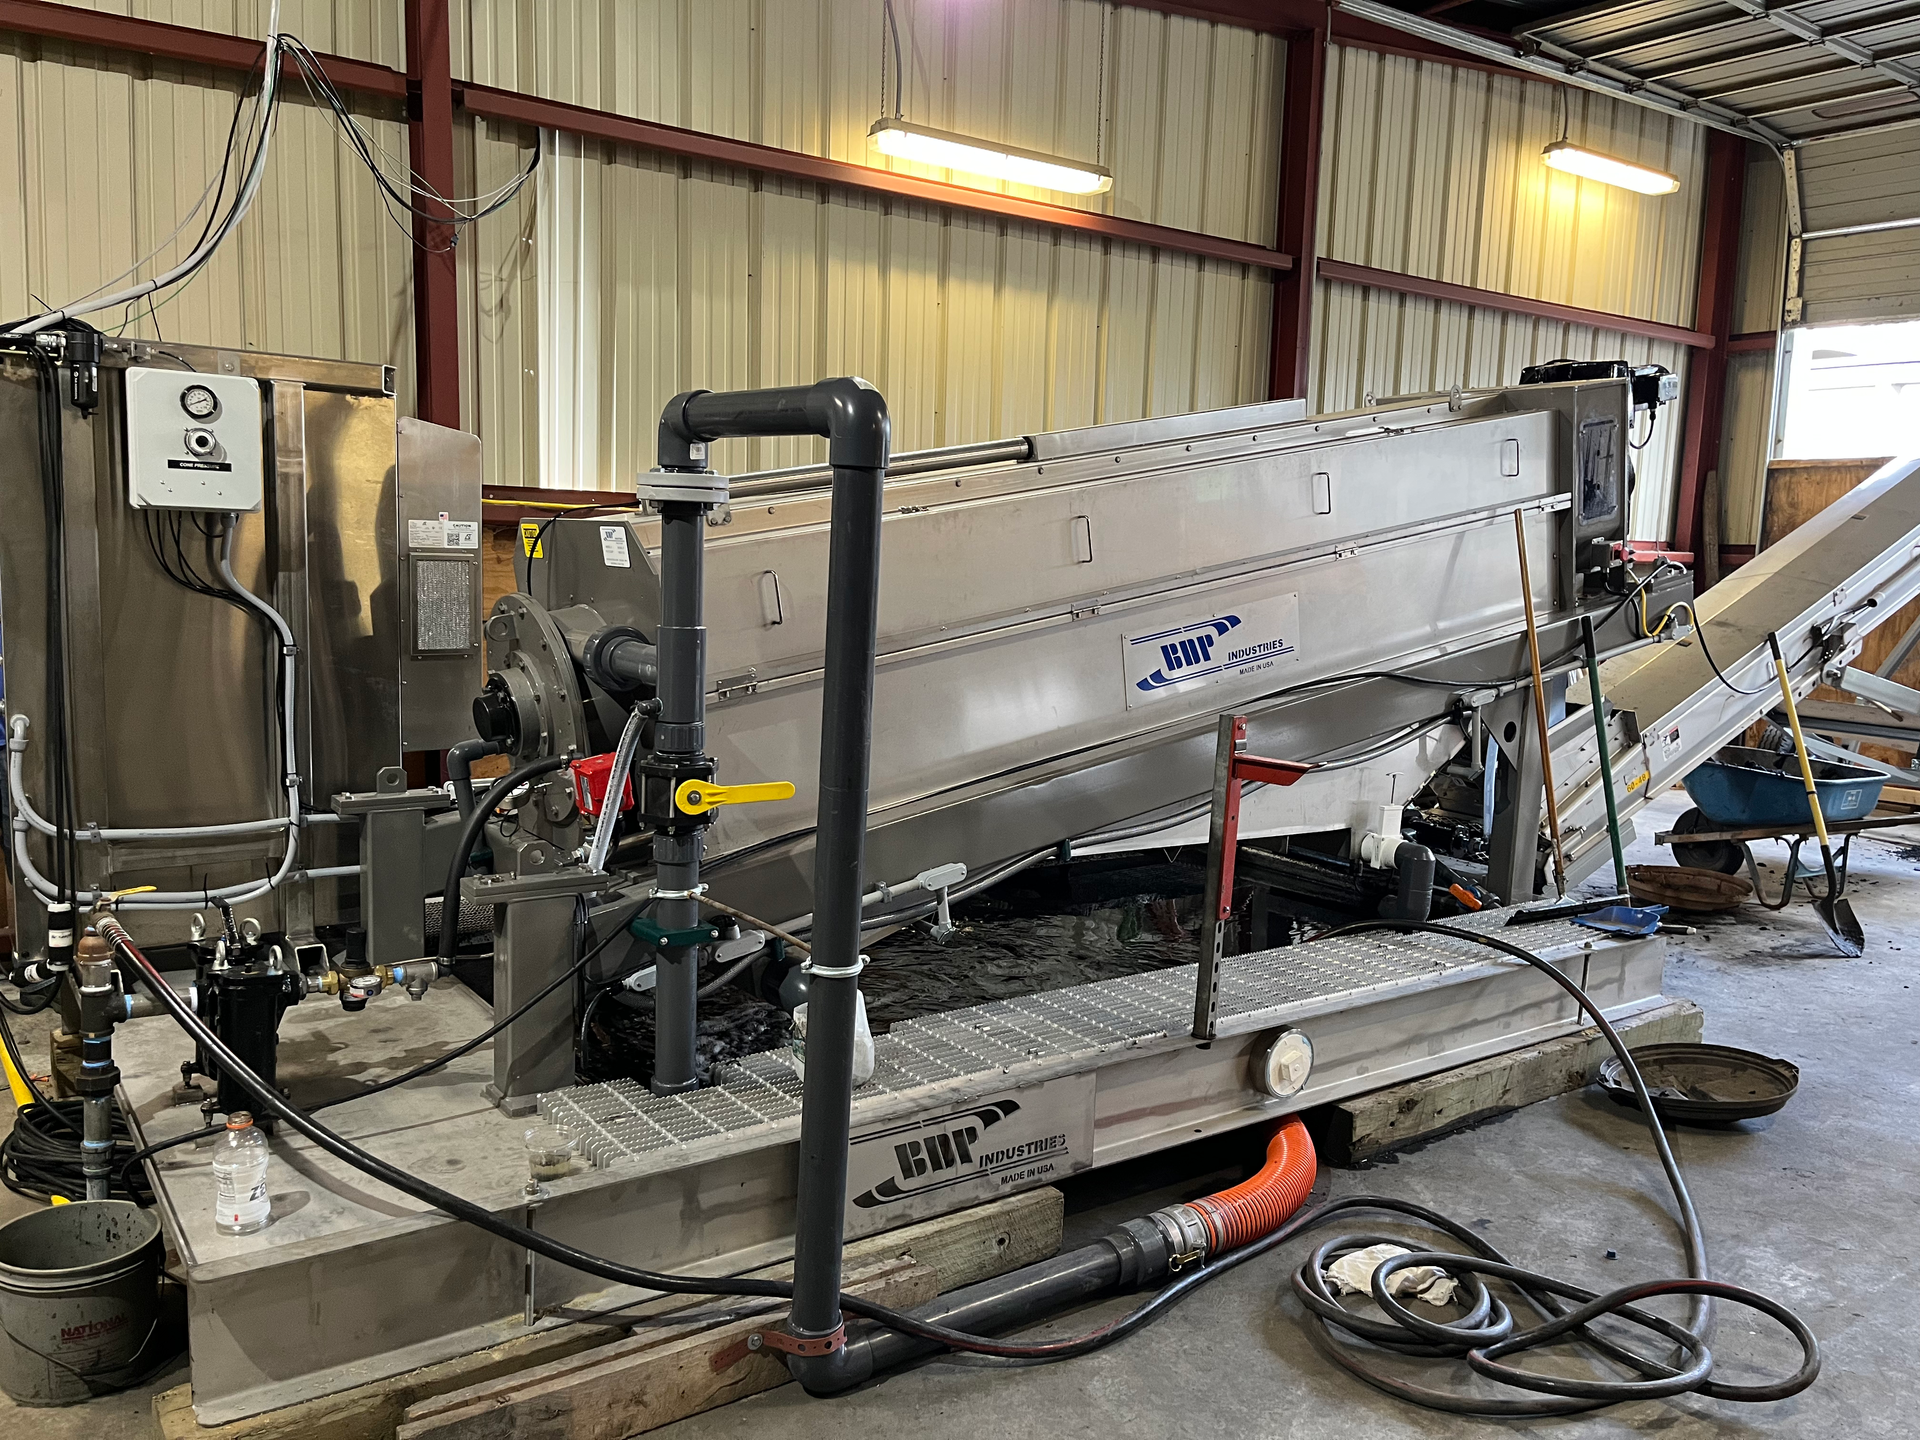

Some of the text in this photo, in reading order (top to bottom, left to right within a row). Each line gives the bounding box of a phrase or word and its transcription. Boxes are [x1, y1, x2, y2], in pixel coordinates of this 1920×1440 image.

[1160, 634, 1215, 671] BDP
[1228, 638, 1284, 662] INDUSTRIES
[1239, 666, 1255, 675] MADE
[1262, 661, 1274, 669] USA
[894, 1125, 979, 1180] BDP
[979, 1133, 1066, 1168] INDUSTRIES
[1001, 1162, 1055, 1186] MADE IN USA
